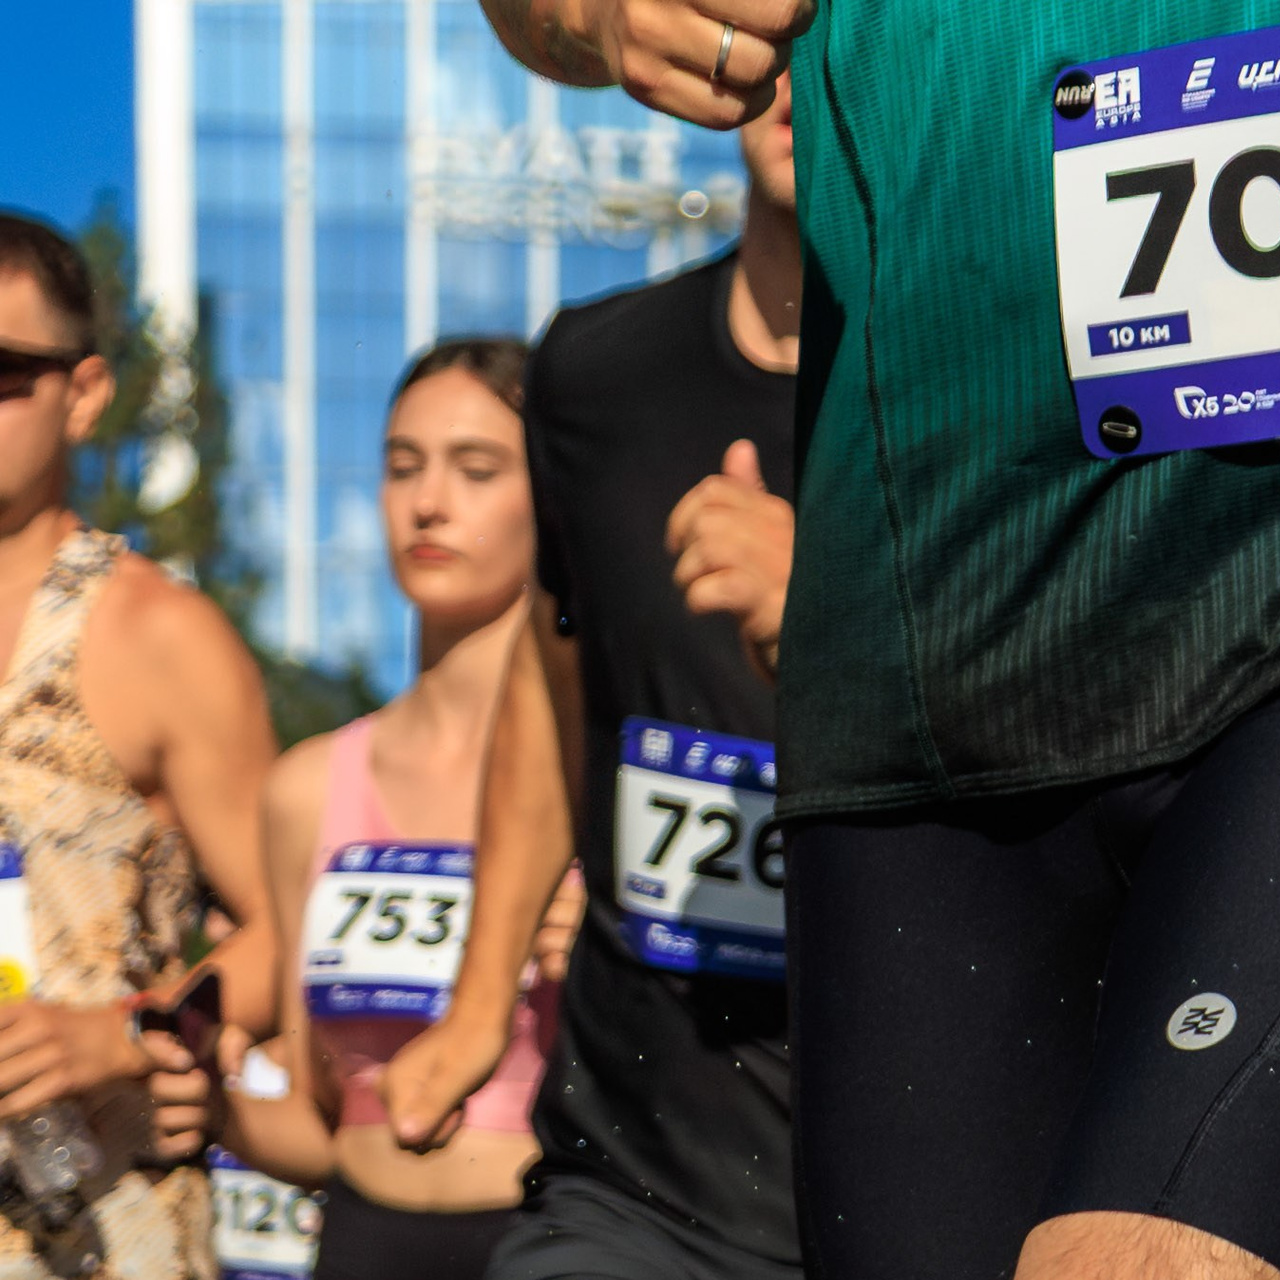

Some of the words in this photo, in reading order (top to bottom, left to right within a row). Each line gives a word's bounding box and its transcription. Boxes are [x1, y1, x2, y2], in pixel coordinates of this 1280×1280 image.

[1096, 103, 1141, 119] EUROPE
[1108, 326, 1135, 349] 10
[329, 888, 461, 945] 753
